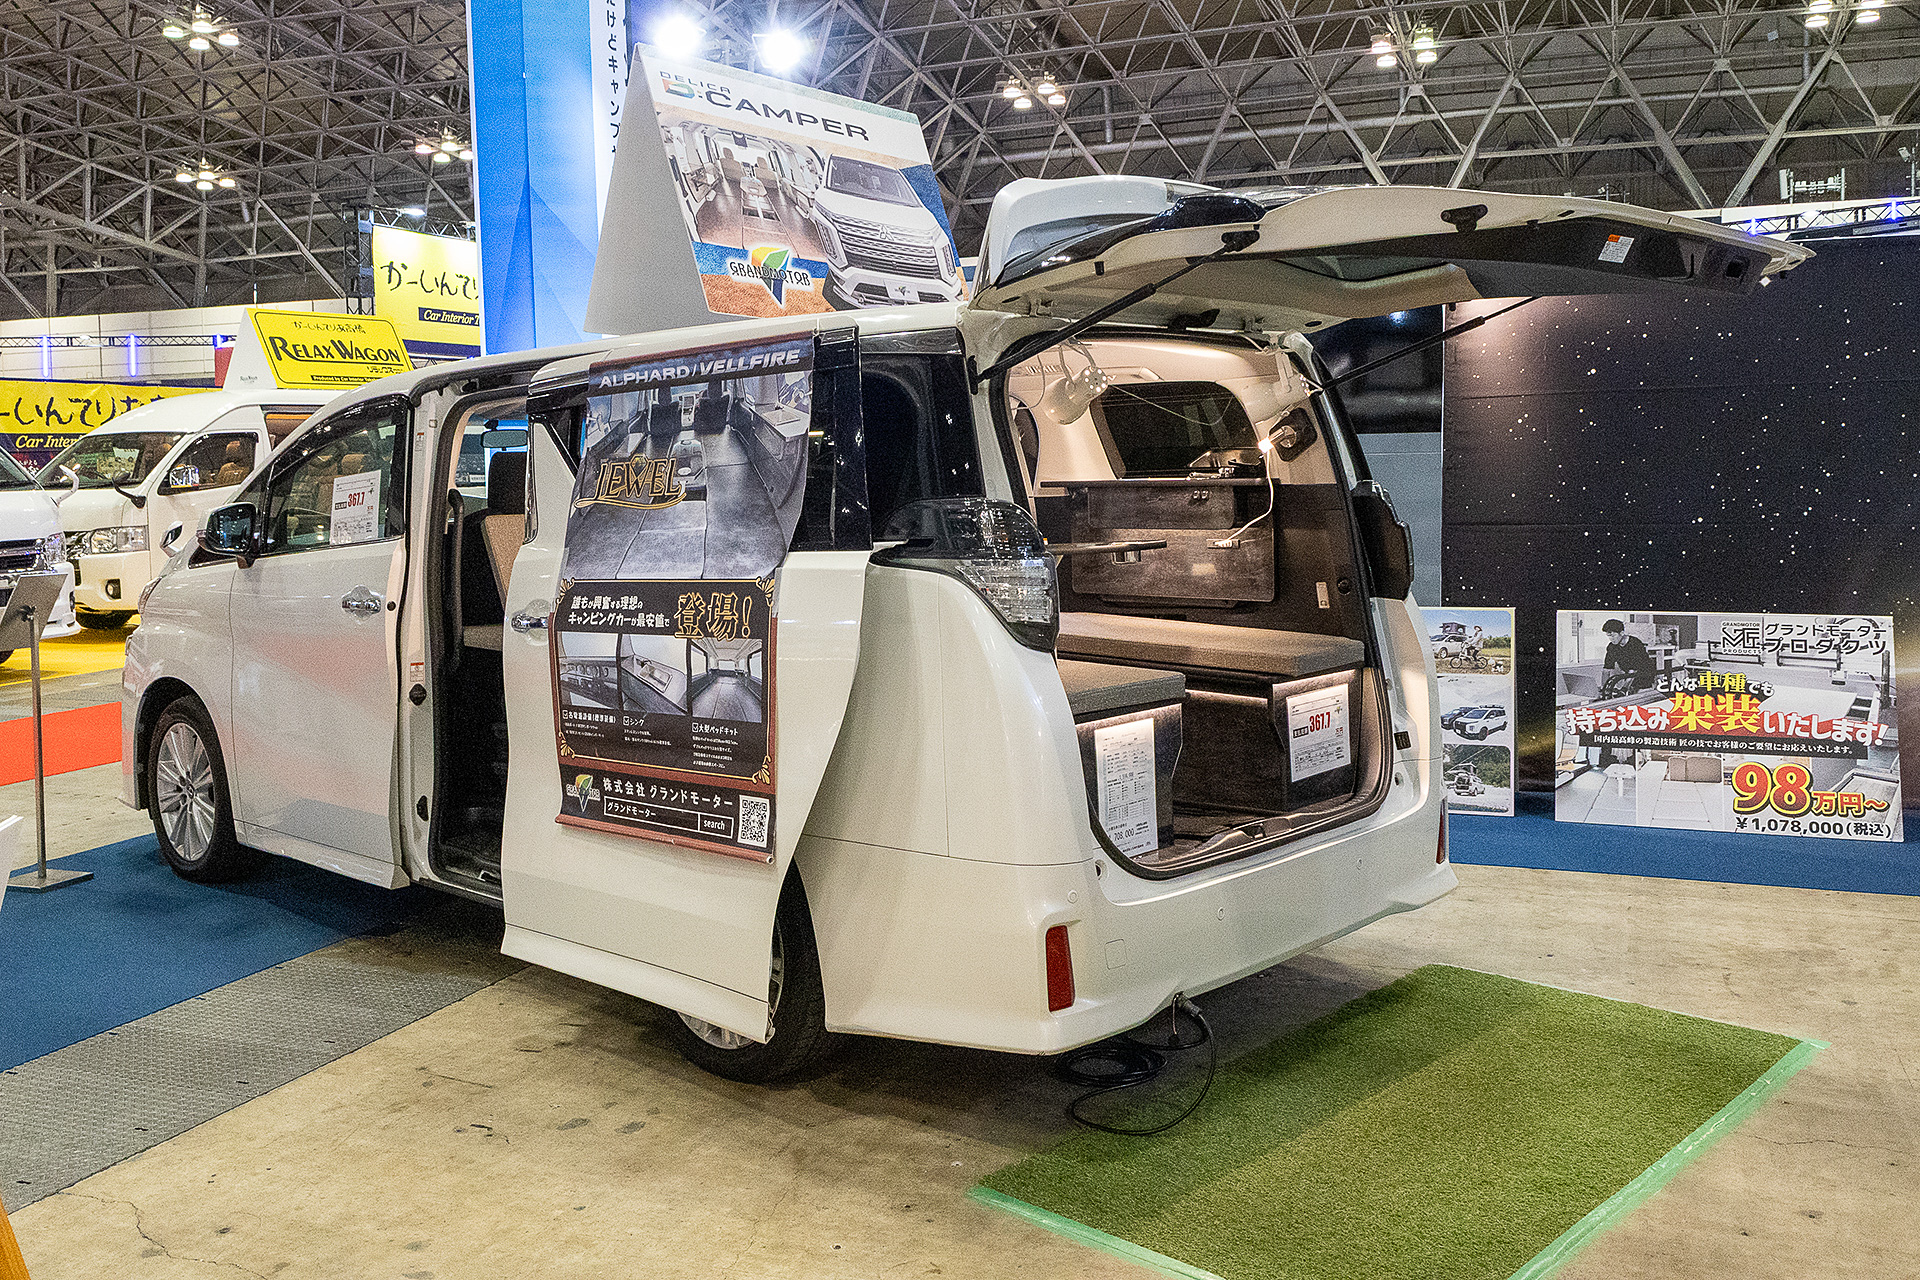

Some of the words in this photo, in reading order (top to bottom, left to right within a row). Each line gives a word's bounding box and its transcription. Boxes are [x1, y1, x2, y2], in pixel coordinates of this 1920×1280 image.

[659, 70, 731, 95] DELICA
[423, 309, 441, 321] Car
[442, 311, 473, 325] Interior
[268, 336, 335, 362] RELAX
[330, 339, 401, 363] WAGON
[16, 435, 41, 449] Car
[43, 434, 83, 448] Inter
[590, 454, 684, 502] JEWEL
[673, 592, 753, 642] 登場!
[1764, 623, 1887, 638] グランドモーター
[1764, 637, 1887, 656] プロダクツ
[1656, 671, 1775, 697] どんな車種でも
[1309, 711, 1331, 732] 367.7
[602, 777, 645, 798] 株式会社
[649, 784, 733, 809] グランドモーター
[606, 802, 657, 818] グランドモーター
[703, 818, 726, 831] search
